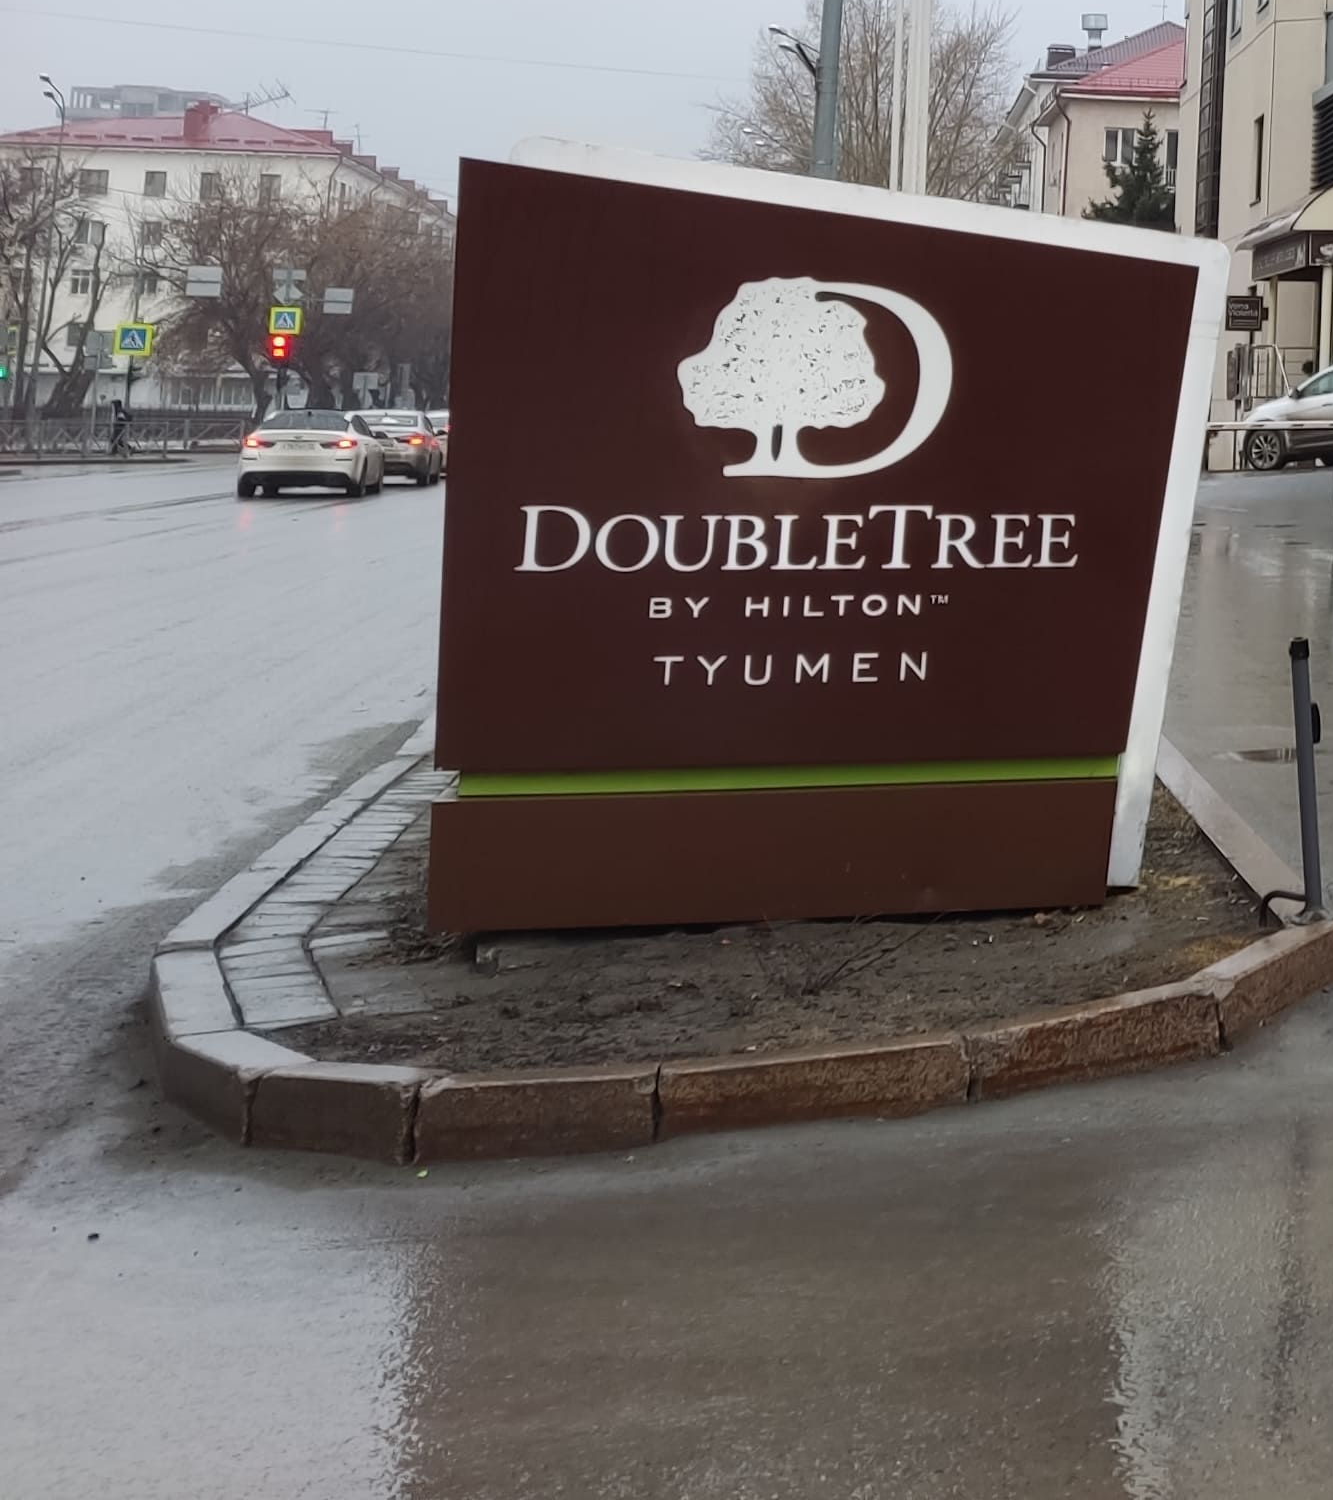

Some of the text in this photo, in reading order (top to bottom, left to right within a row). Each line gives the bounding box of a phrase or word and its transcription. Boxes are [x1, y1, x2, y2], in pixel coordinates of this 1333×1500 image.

[513, 505, 1078, 572] DOUBLETREE
[649, 596, 709, 618] BY
[654, 651, 928, 686] TYUMEN
